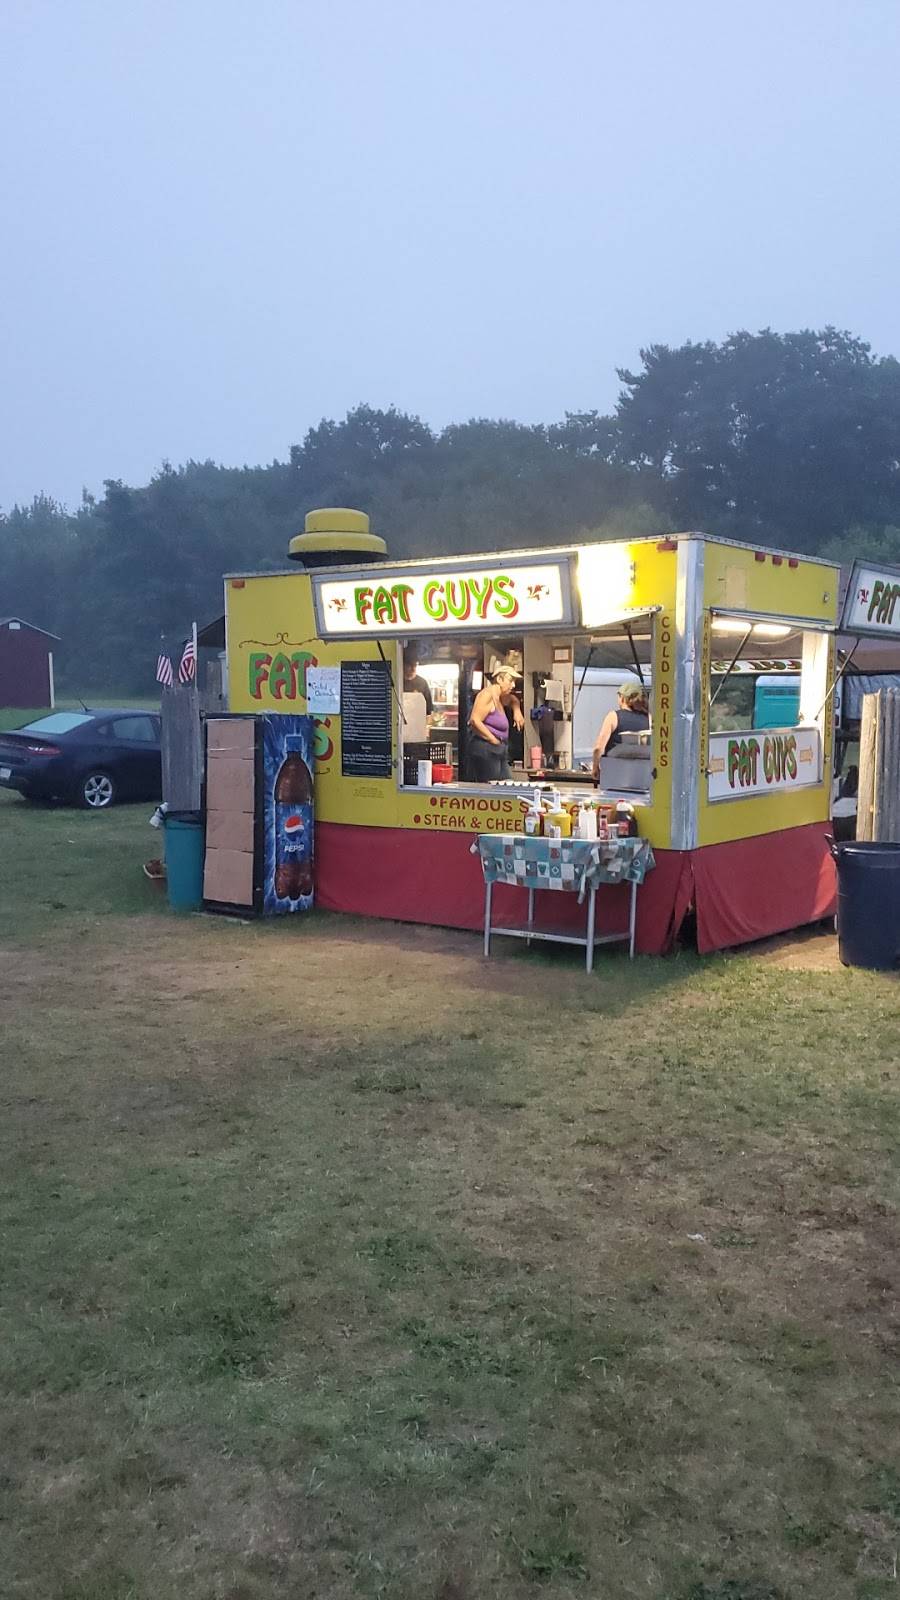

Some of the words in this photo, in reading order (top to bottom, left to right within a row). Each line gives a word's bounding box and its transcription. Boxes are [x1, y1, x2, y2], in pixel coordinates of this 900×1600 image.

[354, 584, 414, 625] FAT
[423, 575, 519, 621] GUYS
[661, 616, 671, 673] COLD
[249, 651, 318, 699] FAT
[660, 683, 670, 767] DRINKS
[728, 738, 760, 788] FAT
[763, 735, 797, 784] GUYS
[424, 814, 466, 828] STEAK
[470, 817, 481, 829] &
[486, 818, 522, 832] CHEE
[440, 797, 513, 812] FAMOUS
[284, 844, 305, 852] PEPSI
